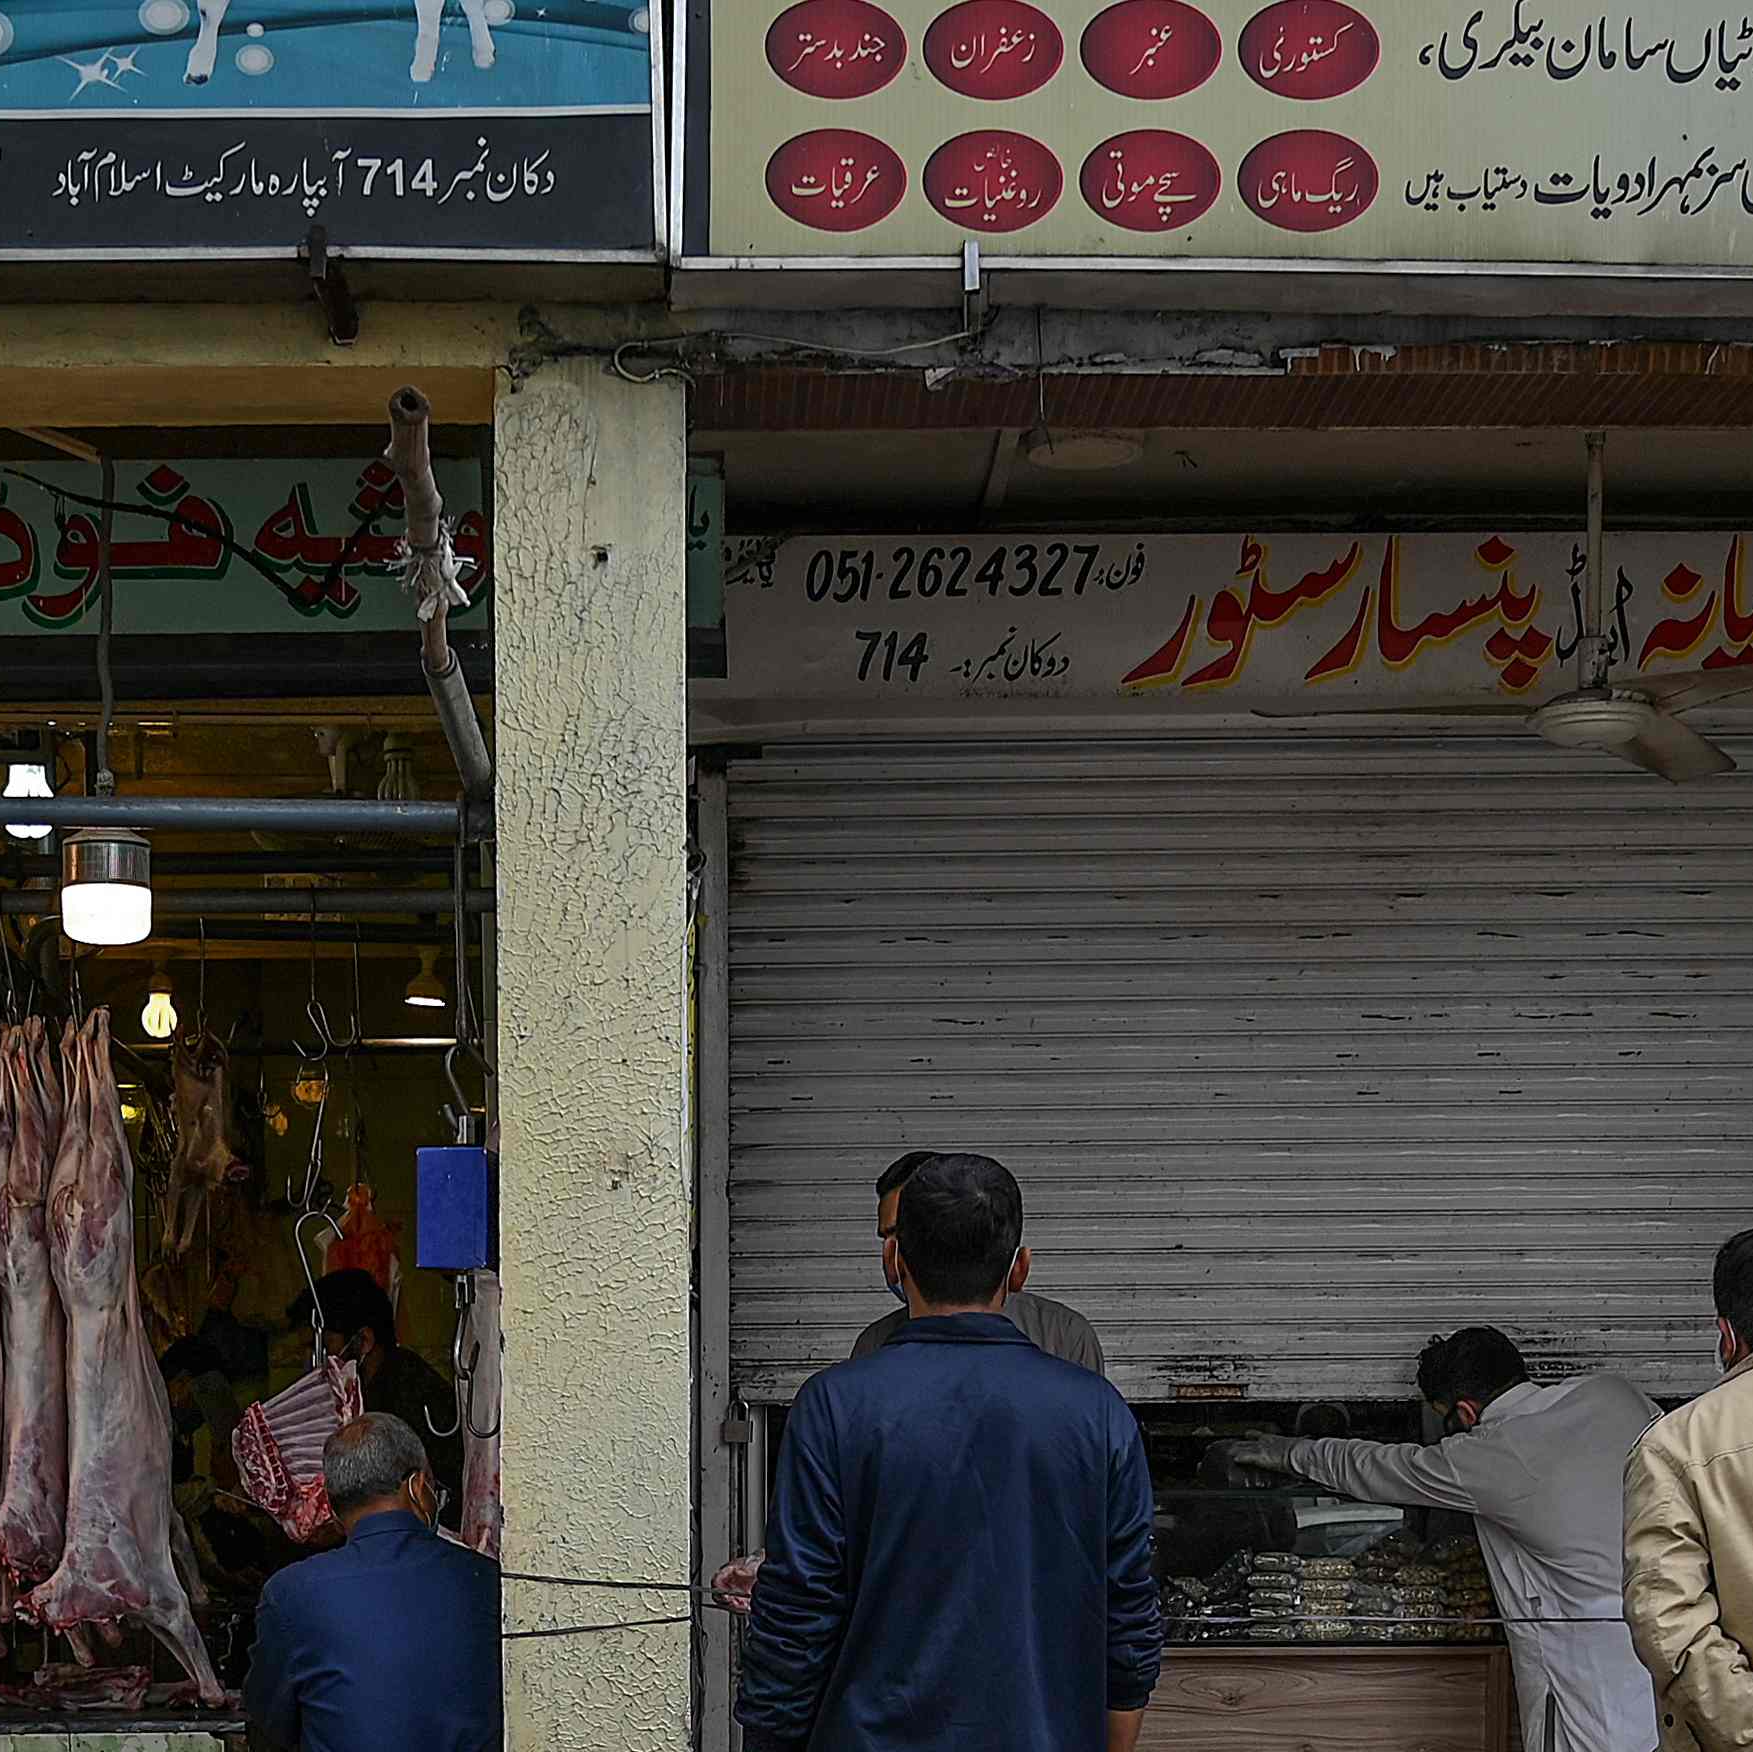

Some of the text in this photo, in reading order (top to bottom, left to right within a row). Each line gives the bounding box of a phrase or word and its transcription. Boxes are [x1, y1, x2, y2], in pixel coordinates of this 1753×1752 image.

[949, 26, 1036, 73] زعفران
[1545, 16, 1669, 80] سامان
[357, 157, 438, 198] 714
[854, 630, 930, 682] 714
